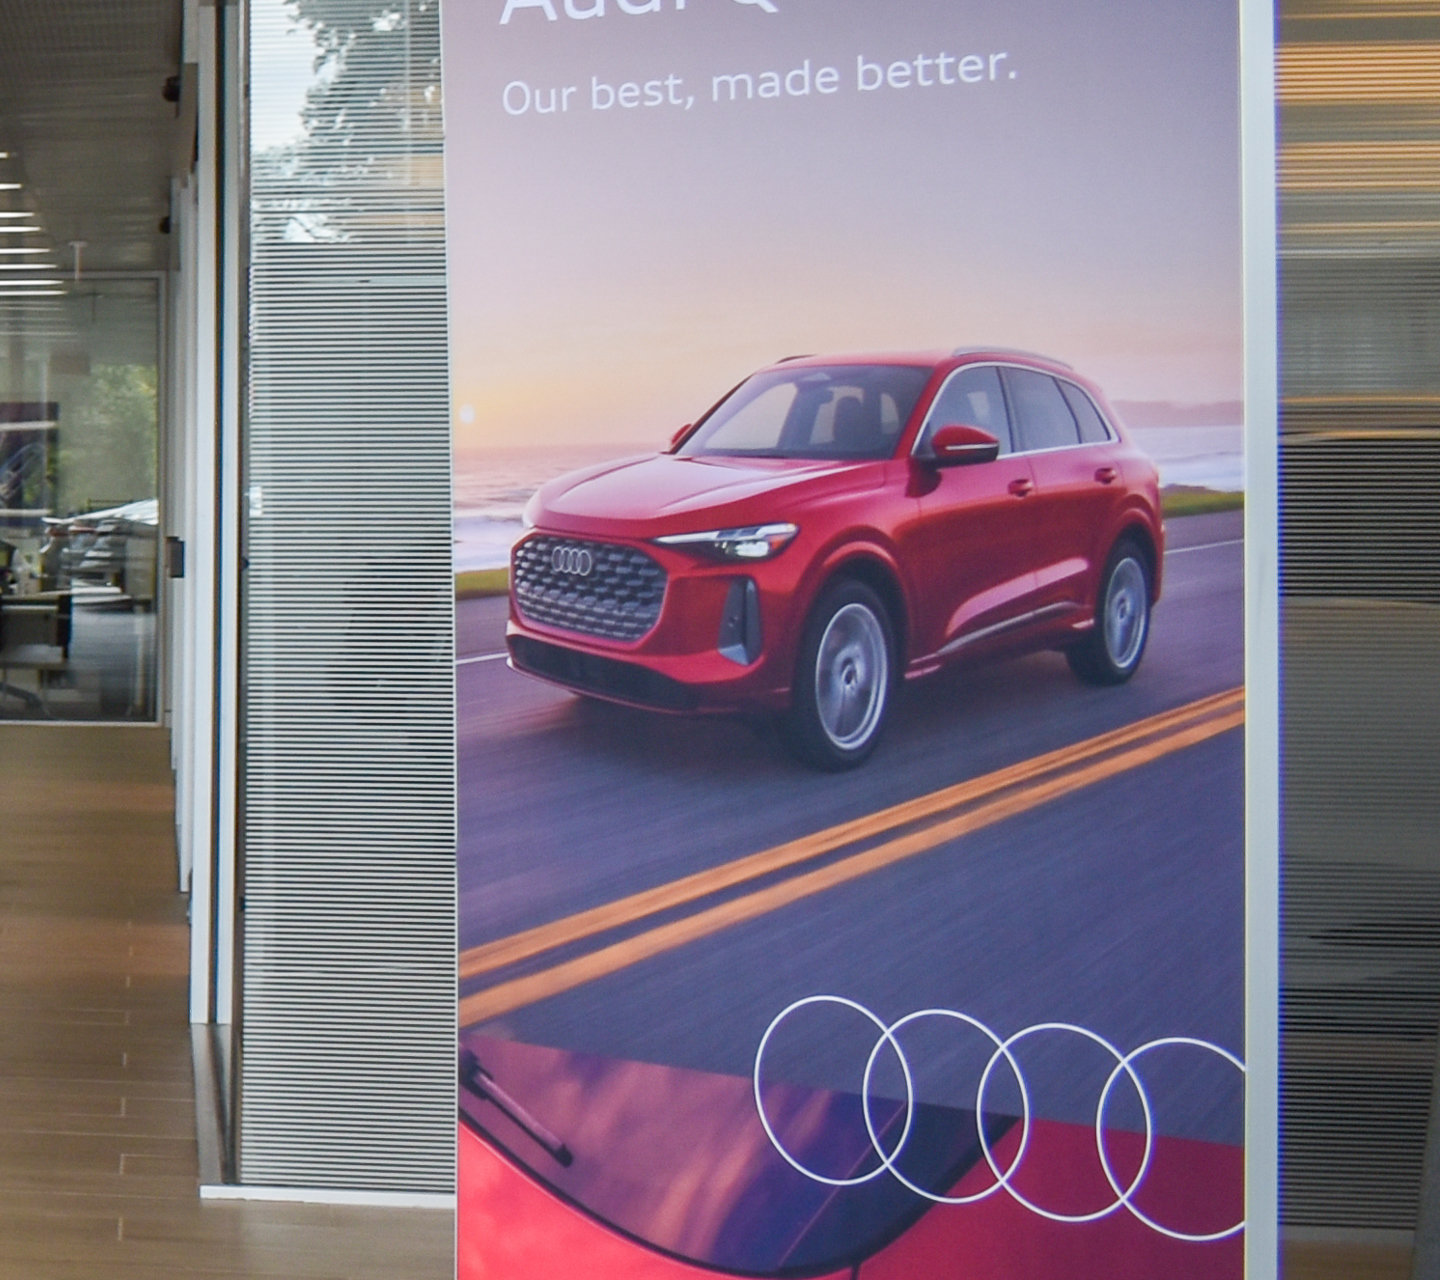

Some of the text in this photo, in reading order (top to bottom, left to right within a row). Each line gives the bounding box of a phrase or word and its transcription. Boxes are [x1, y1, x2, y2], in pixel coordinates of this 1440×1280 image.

[502, 51, 1018, 116] Our best, made better.
